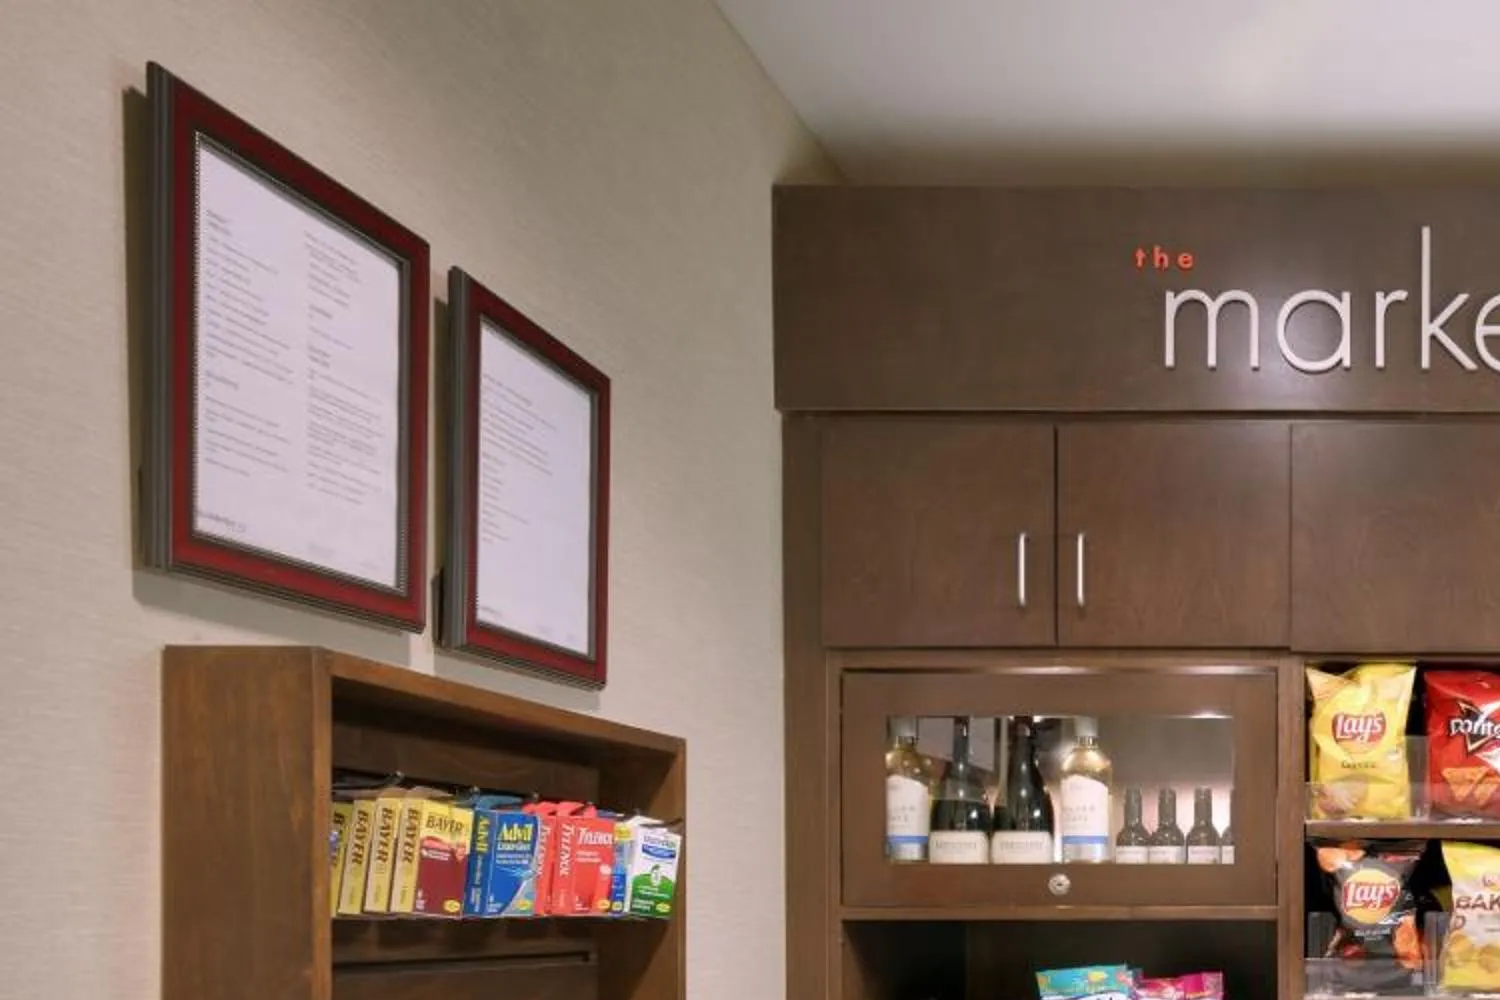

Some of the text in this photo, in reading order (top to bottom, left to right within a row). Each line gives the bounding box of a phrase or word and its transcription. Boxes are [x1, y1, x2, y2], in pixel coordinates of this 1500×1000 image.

[1134, 246, 1194, 269] the
[1334, 712, 1385, 742] Lay's
[426, 815, 465, 833] BAYER
[500, 822, 535, 842] Advil
[1345, 880, 1398, 909] Lay's
